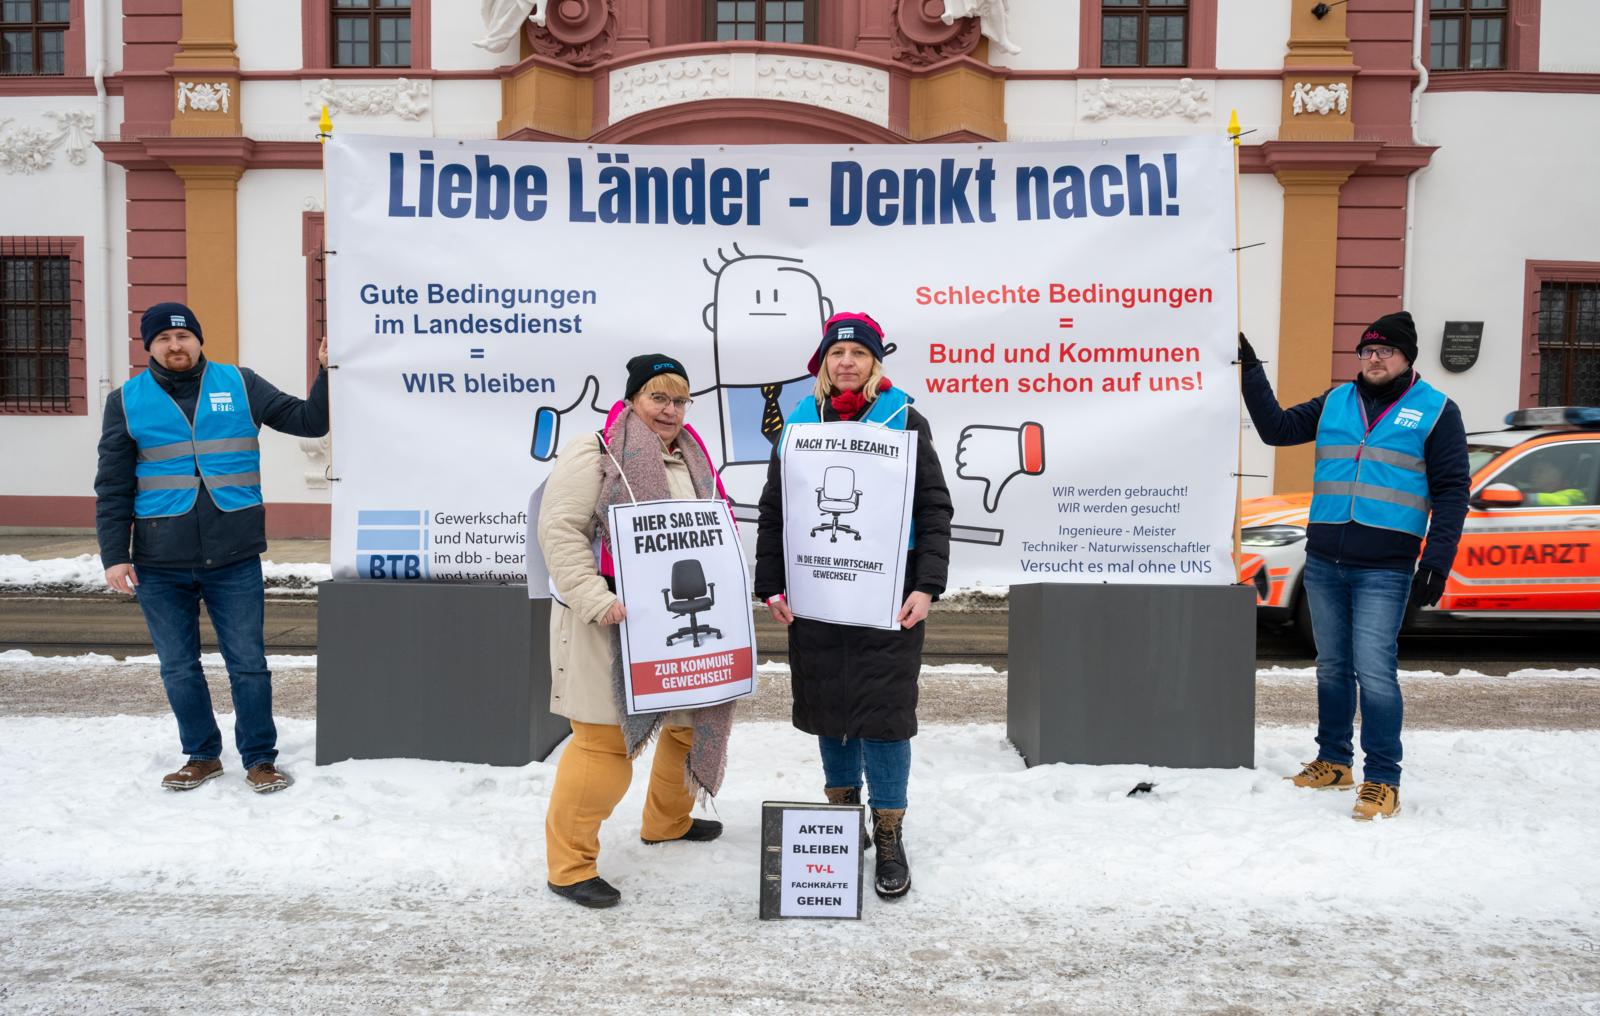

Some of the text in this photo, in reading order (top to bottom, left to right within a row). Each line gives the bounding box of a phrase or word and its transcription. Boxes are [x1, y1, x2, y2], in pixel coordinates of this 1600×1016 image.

[388, 150, 1179, 226] Liebe Länder - Denkt nach!
[360, 284, 596, 308] Gute Bedingungen
[916, 284, 1212, 308] Schlechte Bedingungen
[374, 314, 581, 334] im Landesdienst
[1060, 318, 1073, 328] =
[470, 349, 484, 359] =
[929, 344, 1200, 364] Bund und Kommunen
[403, 373, 555, 393] WIR bleiben
[926, 372, 1202, 393] warten schon auf uns!
[795, 439, 899, 457] NACH TV-L BEZAHLT!
[1053, 486, 1188, 499] WIR werden gebraucht!
[1058, 503, 1180, 516] WIR werden gesucht!
[435, 512, 527, 524] Gewerkschaft
[632, 515, 666, 532] HIER
[697, 512, 720, 526] EINE
[435, 532, 460, 544] und
[1059, 526, 1122, 538] Ingenieure
[1134, 526, 1176, 536] Meister
[634, 529, 724, 554] FACHKRAFT
[1022, 542, 1077, 552] Techniker
[1089, 542, 1210, 552] Naturwissenschaftler
[434, 553, 450, 563] im
[455, 552, 482, 564] dbb
[1467, 544, 1590, 566] NOTARZT
[370, 555, 420, 579] BTB
[804, 555, 812, 564] DIE
[814, 556, 831, 565] FREIE
[833, 559, 883, 571] WIRTSCHAFT
[1021, 559, 1212, 573] Versucht es mal ohne UNS
[436, 572, 462, 580] und
[813, 570, 857, 581] GEWECHSELT
[655, 654, 734, 676] ZUR KOMMUNE
[662, 670, 732, 689] GEWECHSELT!
[799, 825, 843, 834] AKTEN
[793, 845, 848, 854] BLEIBEN
[806, 864, 834, 873] TV-L
[797, 897, 841, 906] GEHEN
